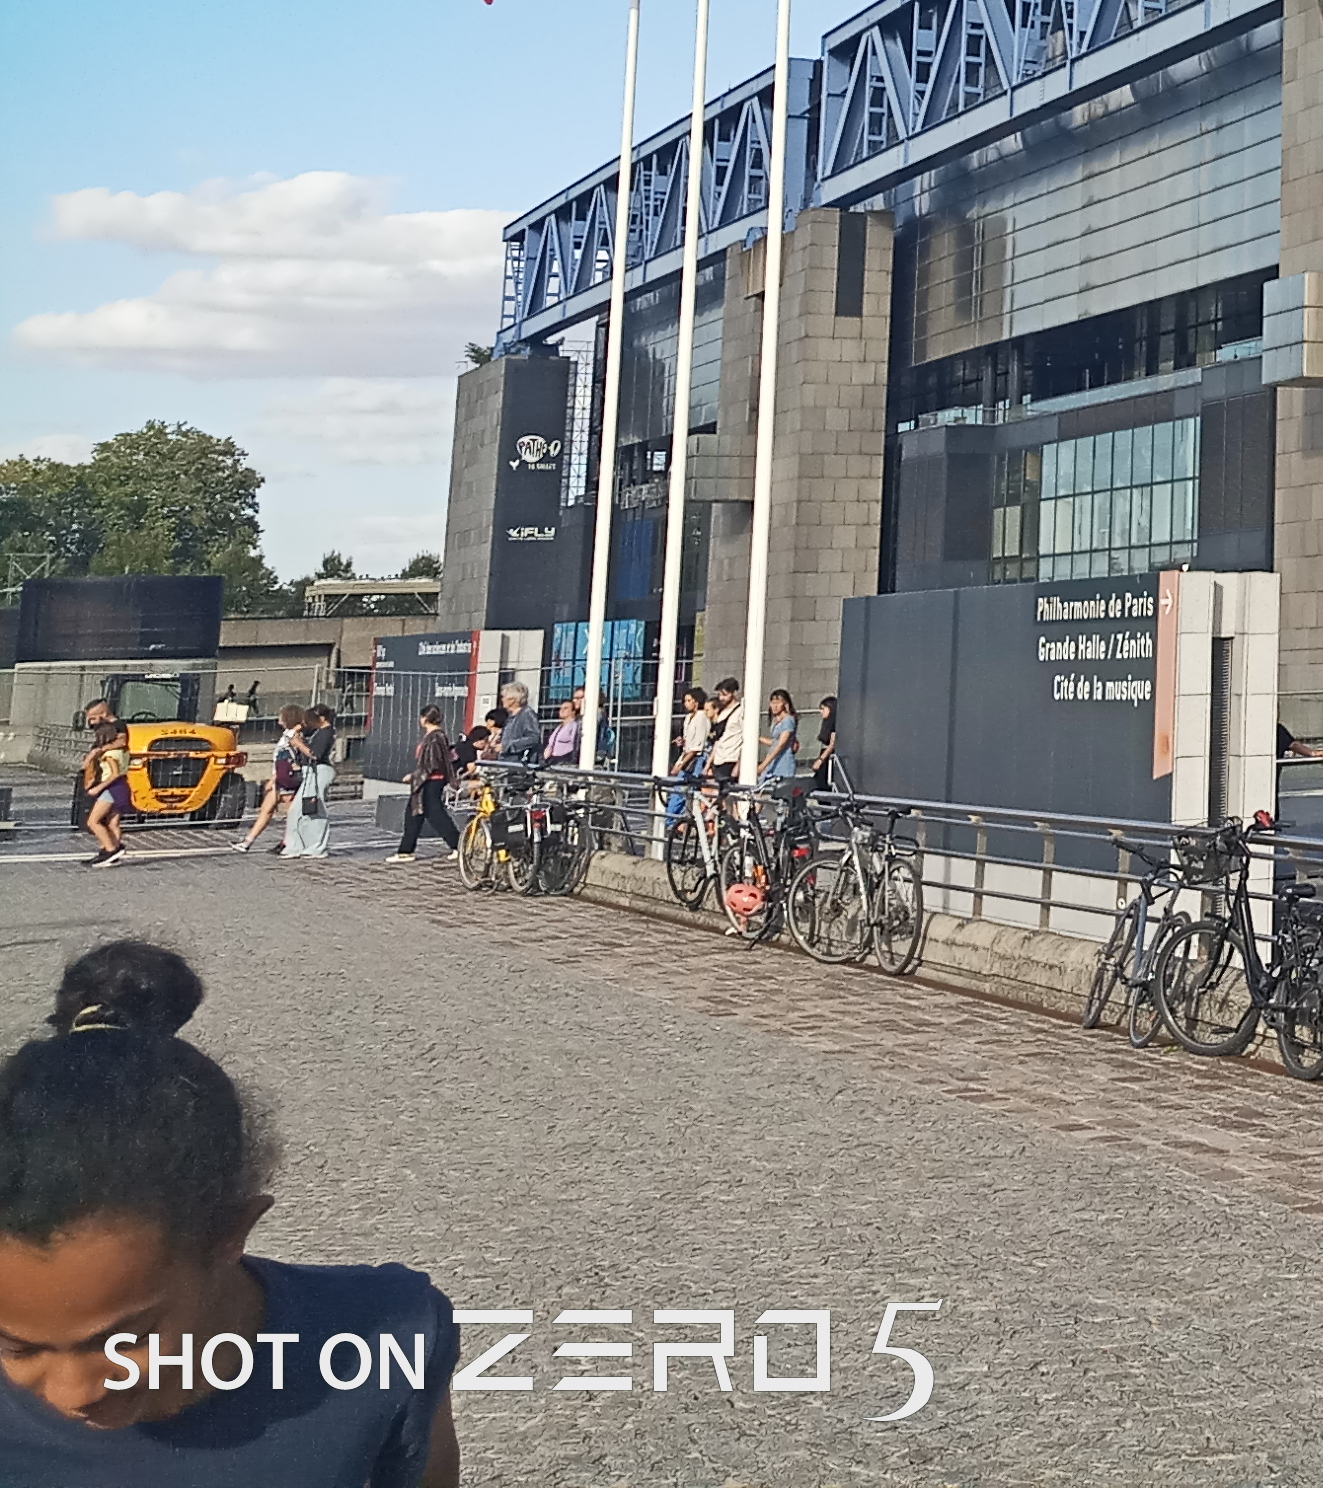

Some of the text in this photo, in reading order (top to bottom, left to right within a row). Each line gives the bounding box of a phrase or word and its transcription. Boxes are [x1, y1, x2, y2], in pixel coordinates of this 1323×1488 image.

[1037, 591, 1154, 621] Philharmonie de Paris
[1038, 634, 1076, 661] Grande
[1077, 633, 1106, 660] Halle
[1115, 631, 1153, 658] Zénith
[1053, 673, 1151, 707] Cité de la musique
